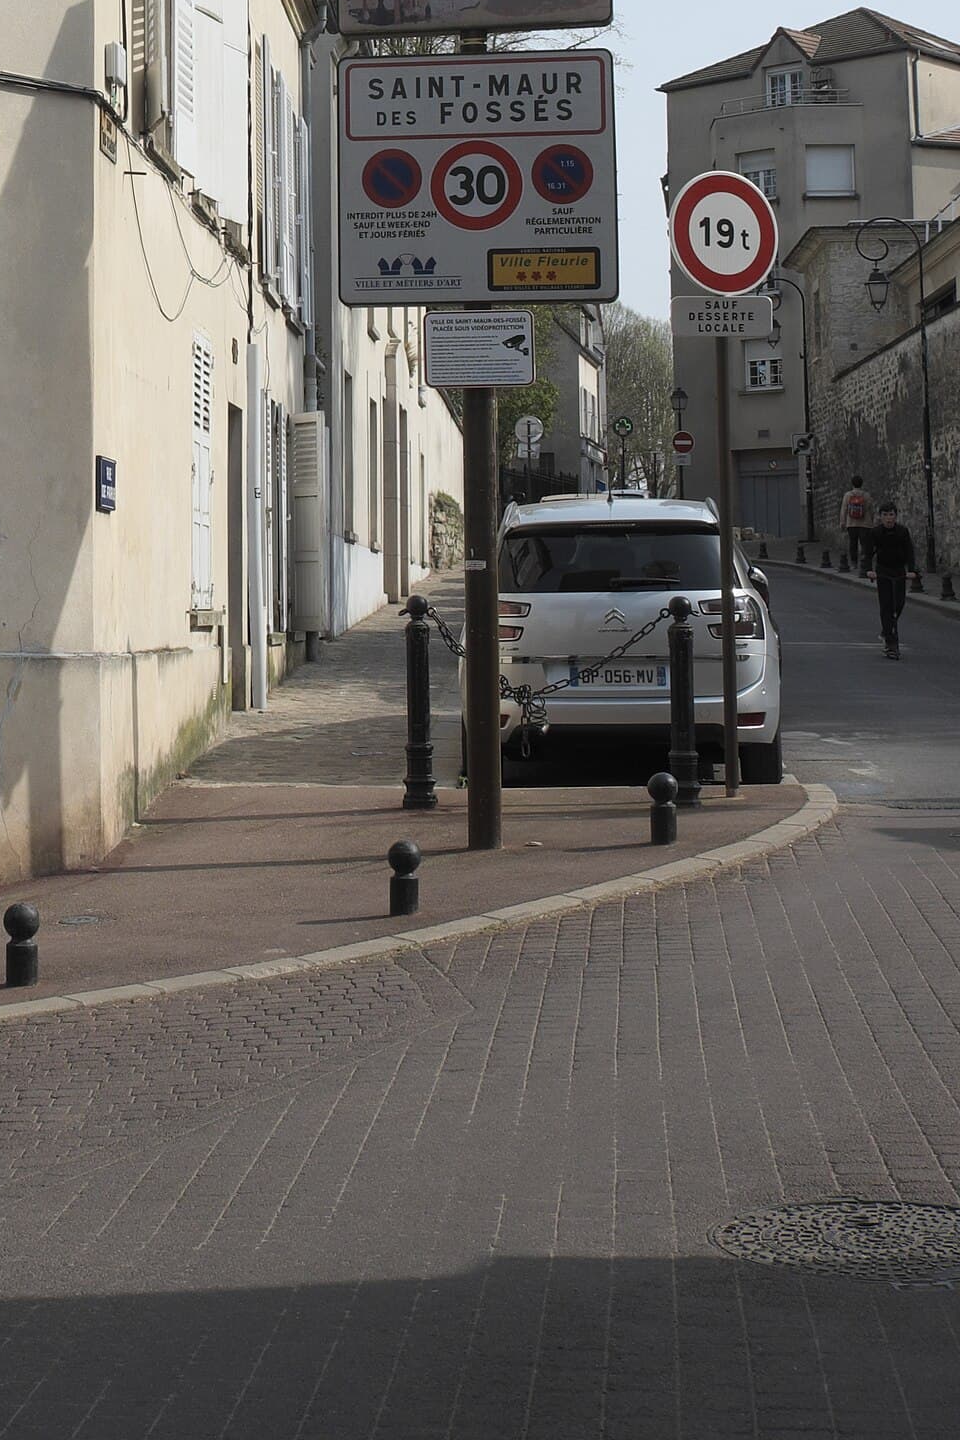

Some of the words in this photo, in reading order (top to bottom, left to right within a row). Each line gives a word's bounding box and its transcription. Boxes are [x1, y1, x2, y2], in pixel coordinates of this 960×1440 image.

[376, 111, 417, 126] DES
[439, 95, 574, 125] FOSSÉS
[448, 164, 506, 206] 30
[347, 211, 383, 221] INTERDIT
[384, 210, 407, 220] PLUS
[408, 210, 419, 219] DE
[420, 210, 437, 219] 24H
[551, 207, 575, 216] SAUF
[353, 221, 375, 230] SAUF
[376, 221, 387, 229] LE
[387, 219, 431, 229] WEEK-END
[525, 215, 601, 226] RÉGLEMENTATION
[358, 230, 370, 239] ET
[370, 230, 395, 239] JOURS
[396, 228, 426, 238] FÉRIÉS
[534, 224, 593, 235] PARTICULIÈRE
[499, 256, 532, 268] Ville
[537, 255, 589, 267] Fleurie
[355, 279, 381, 288] VILLE
[382, 279, 394, 288] ET
[395, 277, 434, 288] MÉTIERS
[436, 278, 462, 287] D'ART
[704, 300, 739, 310] SAUF
[688, 312, 755, 321] DESSERTE
[697, 323, 745, 333] LOCALE
